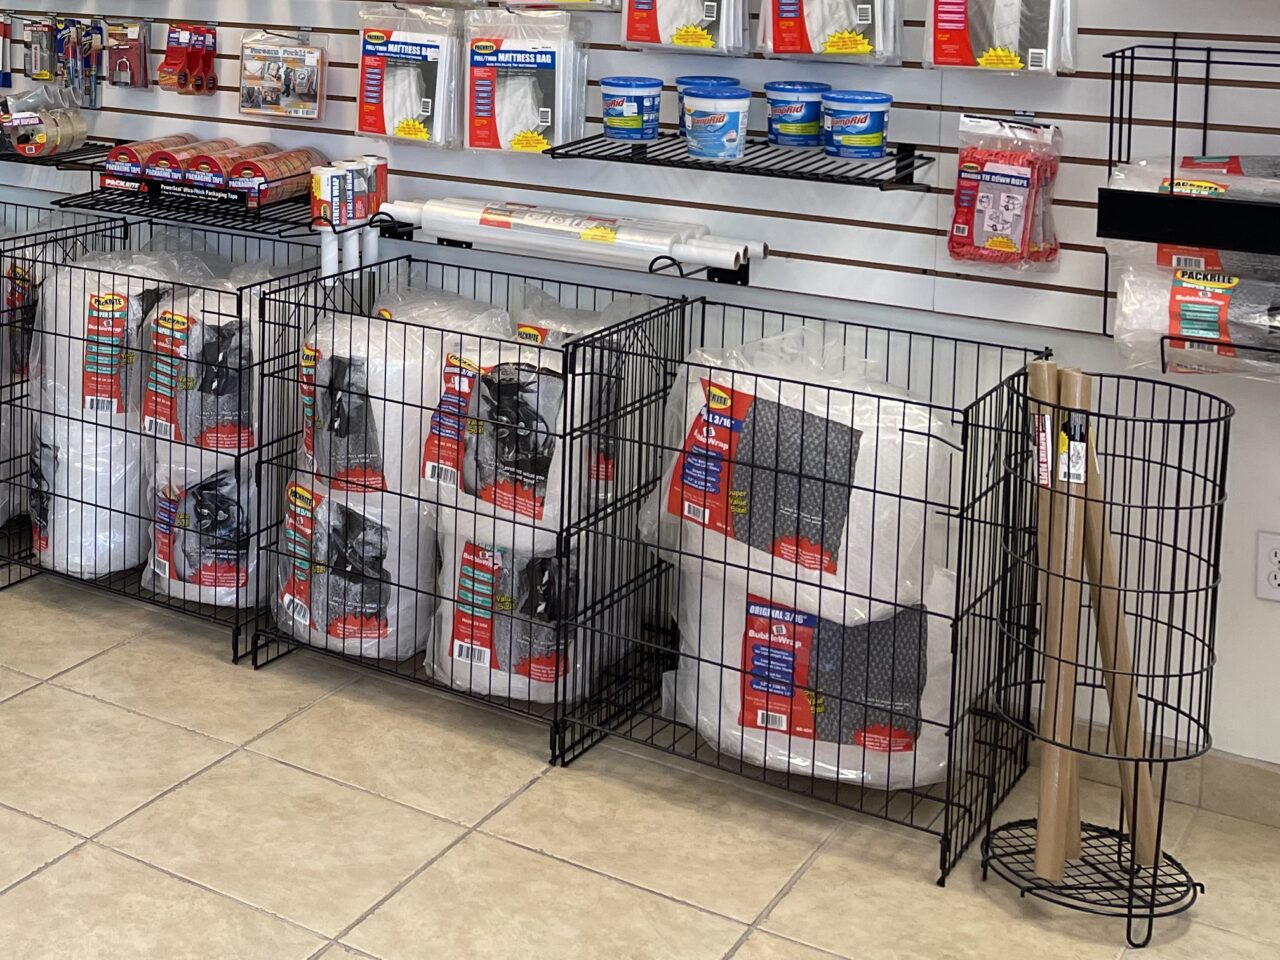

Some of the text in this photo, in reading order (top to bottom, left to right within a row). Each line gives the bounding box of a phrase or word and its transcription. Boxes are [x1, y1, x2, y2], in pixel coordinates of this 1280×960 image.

[388, 44, 421, 54] MATTRESS
[498, 53, 535, 62] MATTRESS
[536, 54, 552, 63] BAG
[1181, 270, 1233, 284] PACKRITE
